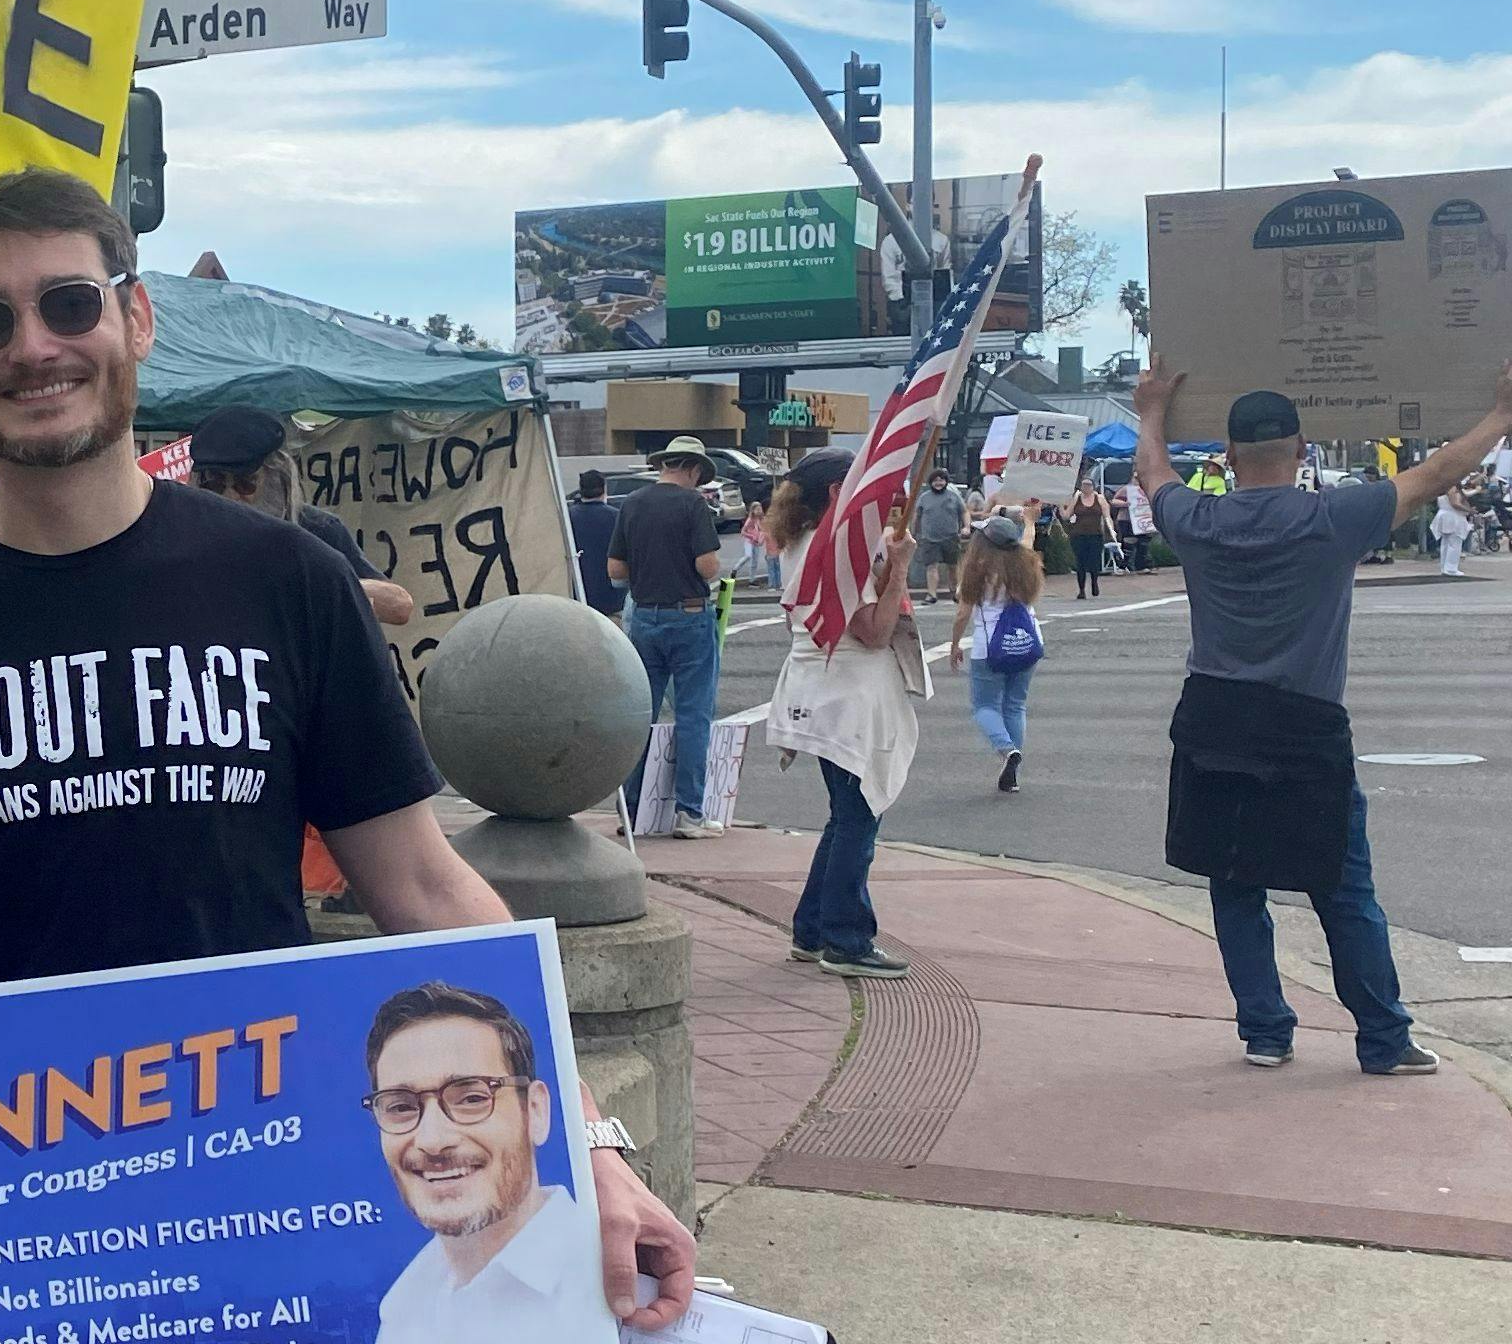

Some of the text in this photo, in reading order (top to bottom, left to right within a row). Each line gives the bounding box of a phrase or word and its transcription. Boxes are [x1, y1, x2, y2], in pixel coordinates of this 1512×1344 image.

[150, 3, 265, 47] Arden
[705, 207, 819, 223] Sac State Fuels Our Region
[1294, 203, 1360, 219] PROJECT
[684, 223, 836, 256] $1.9 BILLION
[1270, 219, 1388, 238] DISPLAY BOARD
[684, 257, 834, 273] IN REGIONAL INDUSTRY ACTIVITY
[1026, 423, 1055, 440] ICE
[1017, 448, 1074, 467] MURDER
[131, 645, 270, 751] FACE
[50, 767, 155, 815] AGAINST
[166, 766, 214, 802] THE
[222, 769, 266, 804] WAR
[20, 1149, 176, 1209] Congress
[205, 1116, 303, 1159] CA-03
[157, 1208, 304, 1243] FIGHTING
[311, 1202, 383, 1228] FOR:
[49, 1271, 200, 1308] Billionaires
[222, 1304, 263, 1331] for
[270, 1297, 311, 1325] All
